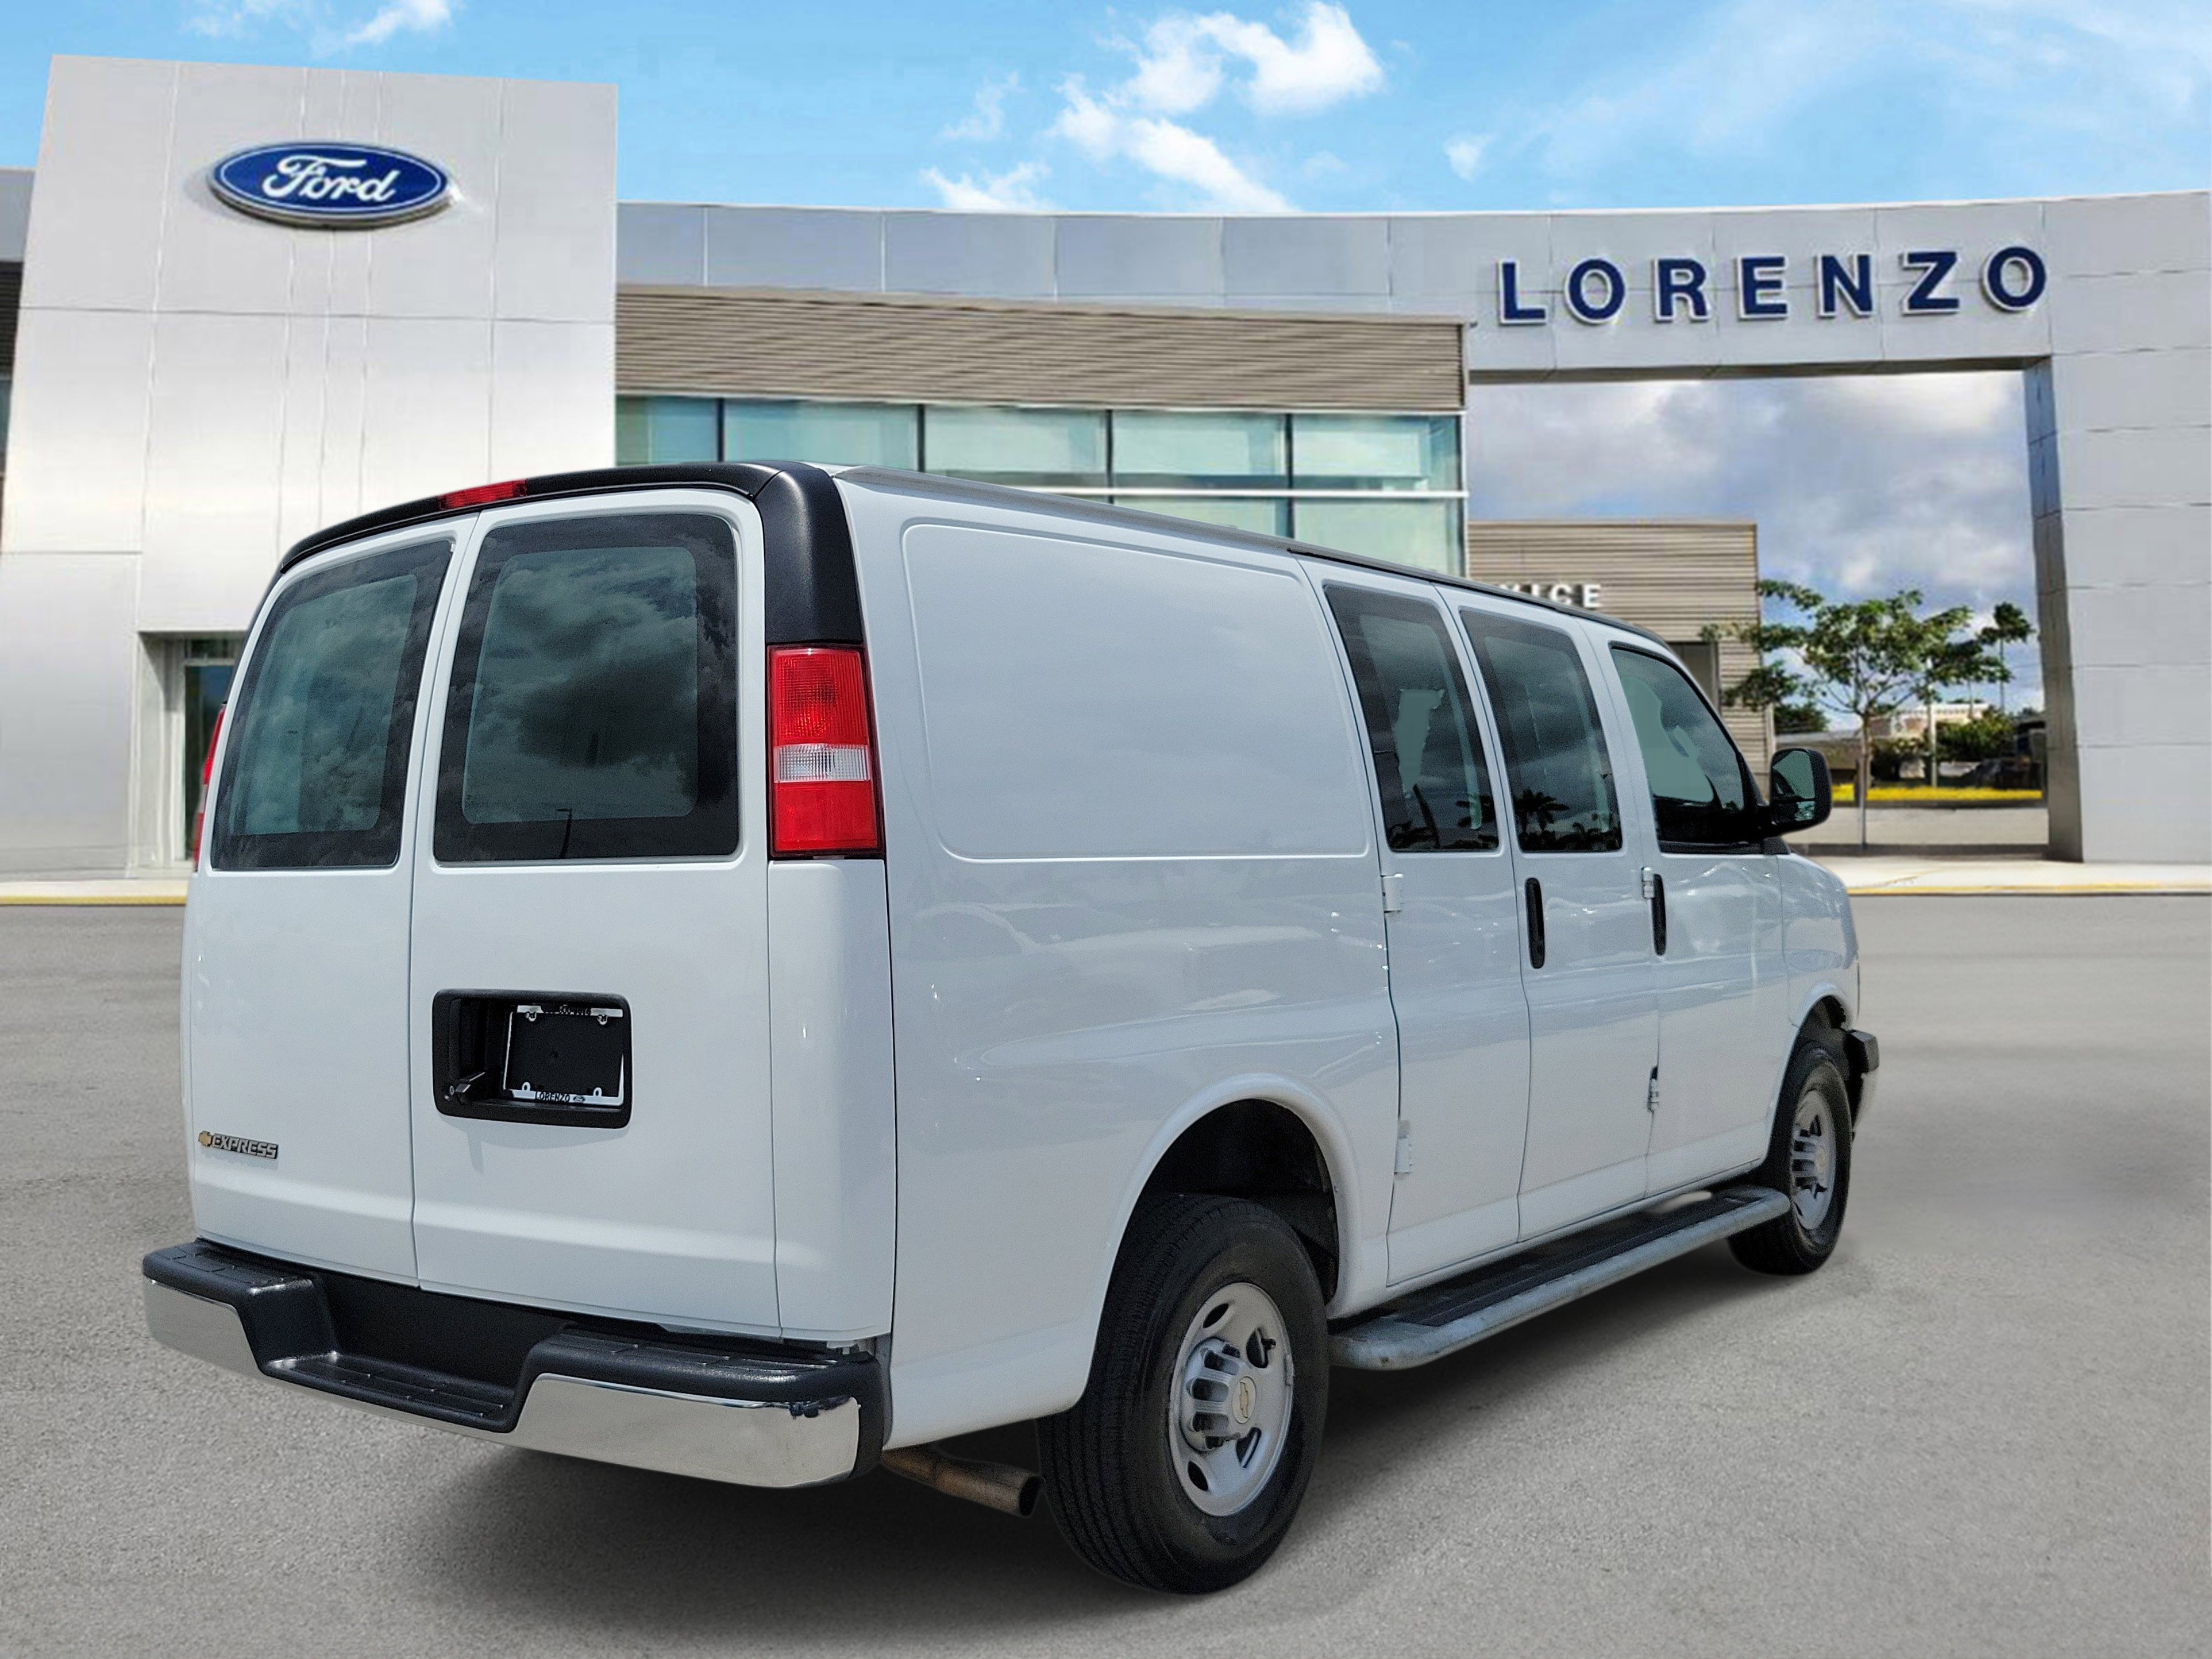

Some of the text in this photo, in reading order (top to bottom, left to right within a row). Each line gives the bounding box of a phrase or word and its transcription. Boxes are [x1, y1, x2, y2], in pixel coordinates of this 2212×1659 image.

[262, 154, 401, 202] Ford
[1498, 247, 2047, 324] LORENZO
[211, 1134, 278, 1159] EXPRESS
